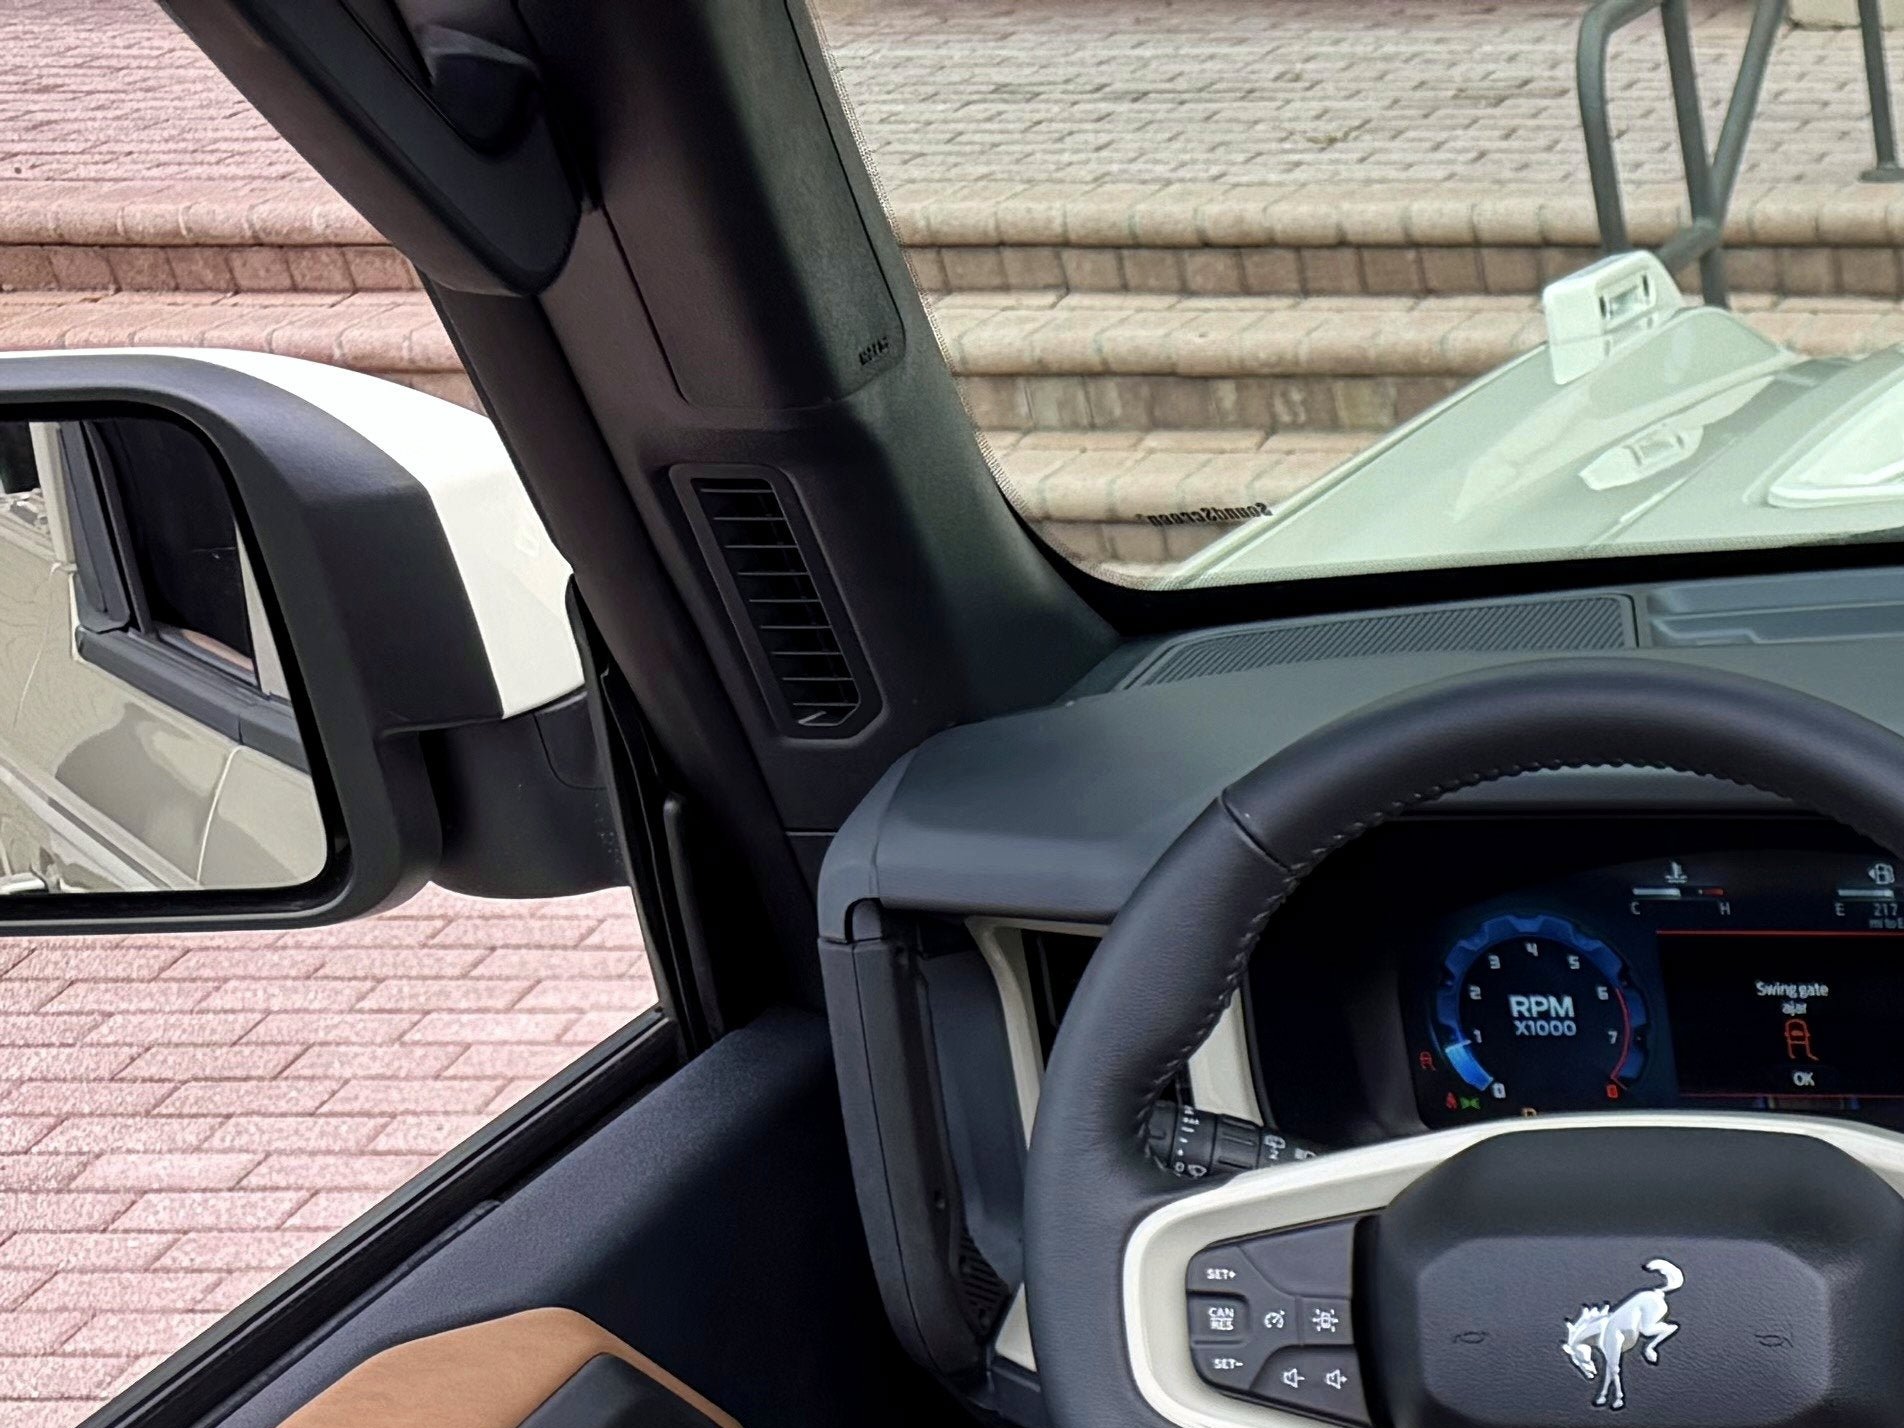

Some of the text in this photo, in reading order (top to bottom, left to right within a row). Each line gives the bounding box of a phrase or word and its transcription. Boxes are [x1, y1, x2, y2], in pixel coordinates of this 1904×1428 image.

[1631, 903, 1641, 915] C
[1719, 903, 1731, 916] H
[1835, 903, 1845, 916] E
[1873, 903, 1898, 917] 217
[1526, 943, 1539, 957] 4
[1489, 955, 1501, 970] 3
[1567, 955, 1580, 970] 5
[1469, 985, 1482, 1000] 2
[1597, 986, 1609, 1000] 6
[1755, 981, 1829, 999] Swing gate
[1508, 995, 1575, 1018] RPM
[1782, 1002, 1807, 1016] ajar
[1514, 1020, 1577, 1036] X1000
[1473, 1029, 1482, 1043] 1
[1608, 1031, 1618, 1044] 7
[1793, 1071, 1815, 1086] OK
[1206, 1268, 1237, 1280] SET+
[1208, 1308, 1235, 1317] CAN
